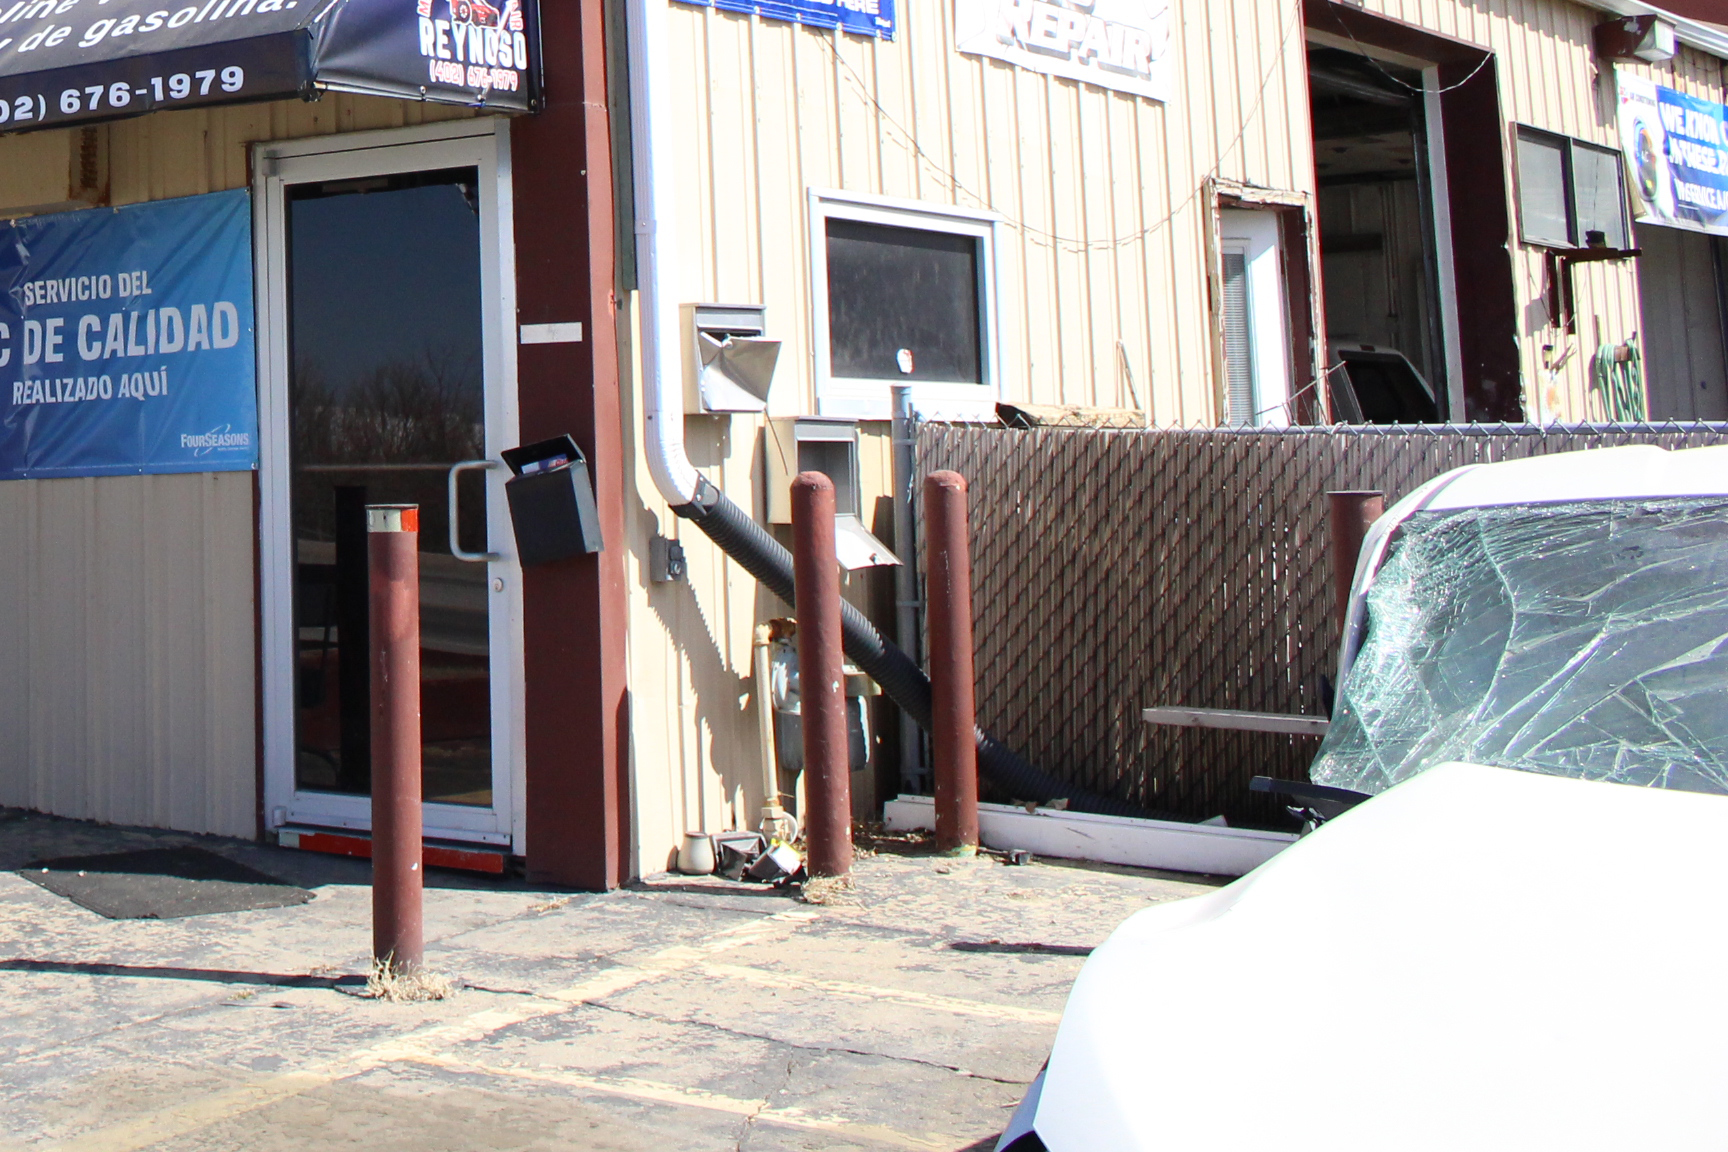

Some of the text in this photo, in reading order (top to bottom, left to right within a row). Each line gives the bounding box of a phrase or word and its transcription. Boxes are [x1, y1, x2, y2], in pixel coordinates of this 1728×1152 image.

[16, 24, 73, 53] de
[418, 16, 528, 71] REYNOSO
[59, 65, 245, 114] 676-1979
[429, 58, 519, 92] (402) 676-1979
[1659, 101, 1685, 135] WE
[23, 270, 152, 306] SERVICIO DEL
[23, 317, 65, 366] DE
[77, 300, 240, 362] CALIDAD
[12, 365, 168, 405] REALIZADO AQUÍ
